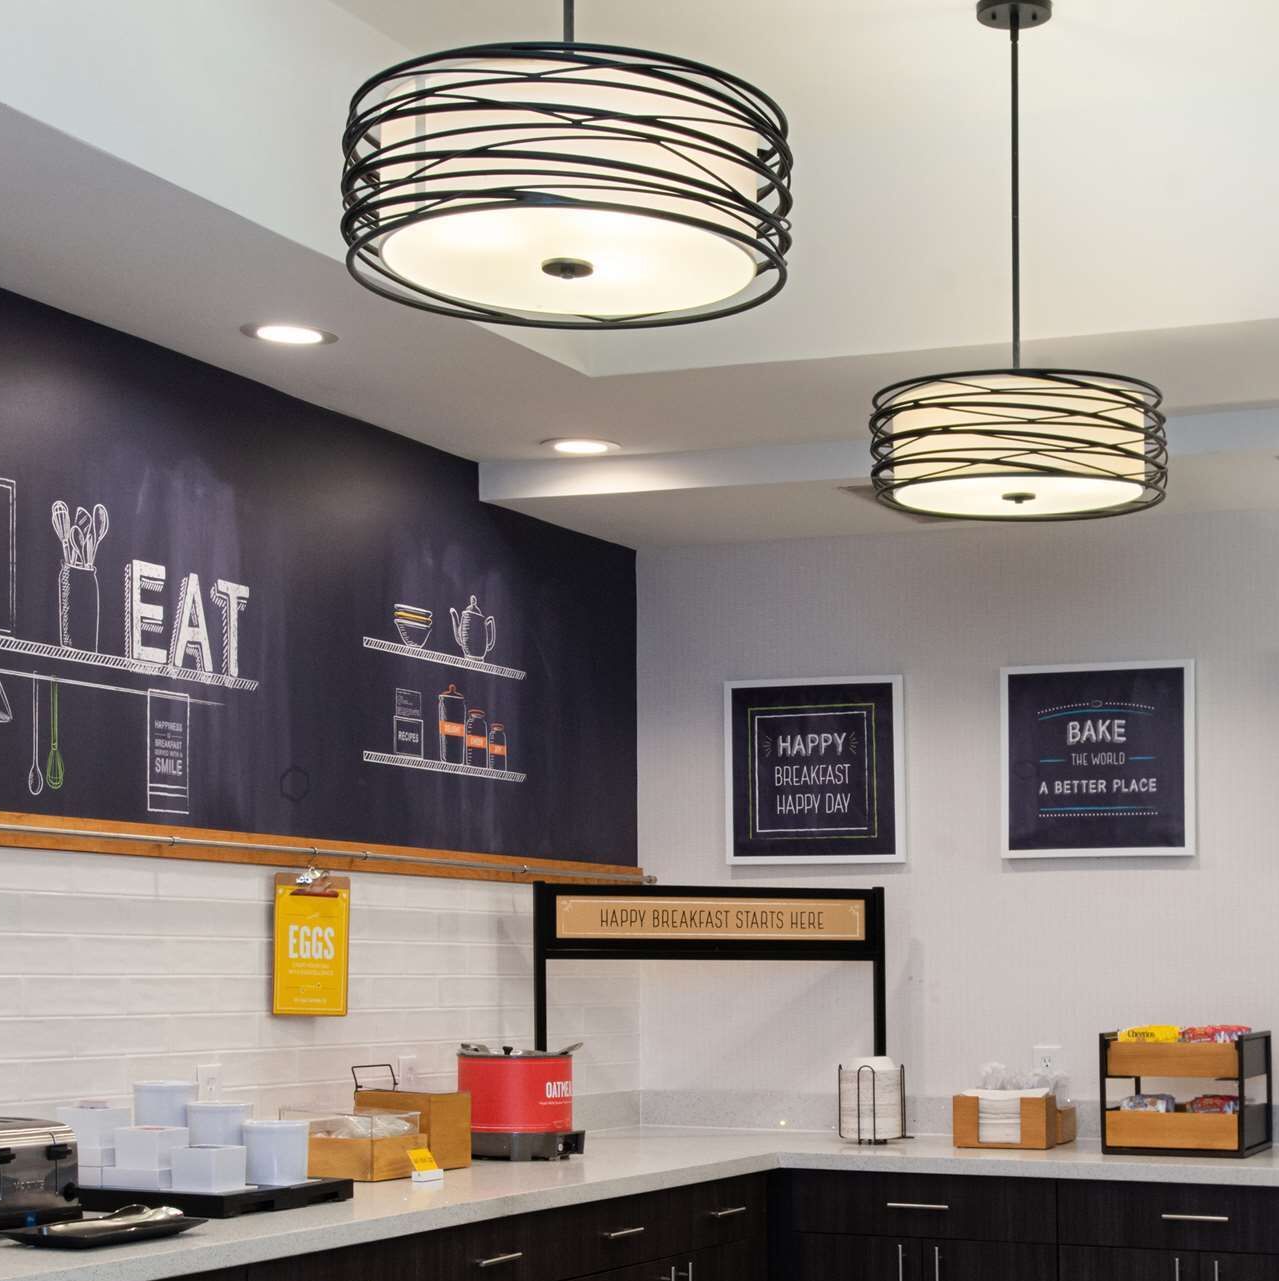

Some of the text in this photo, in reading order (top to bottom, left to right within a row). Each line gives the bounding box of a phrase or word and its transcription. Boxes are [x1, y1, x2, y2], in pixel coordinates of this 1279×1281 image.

[125, 559, 250, 678] EAT
[154, 720, 183, 732] HAPPINESS
[1067, 719, 1127, 745] BAKE
[154, 738, 182, 750] BREAKFAST
[398, 730, 419, 743] RECIPES
[777, 732, 847, 756] HAPPY
[154, 757, 183, 776] SMILE
[1071, 751, 1125, 766] THE WORLD
[775, 763, 851, 786] BREAKFAST
[1039, 778, 1157, 795] A BETTER PLACE
[776, 793, 851, 815] HAPPY DAY
[600, 908, 825, 930] HAPPY BREAKFAST STARTS HERE
[288, 924, 335, 960] EGGS
[1127, 1029, 1155, 1039] Cheerios
